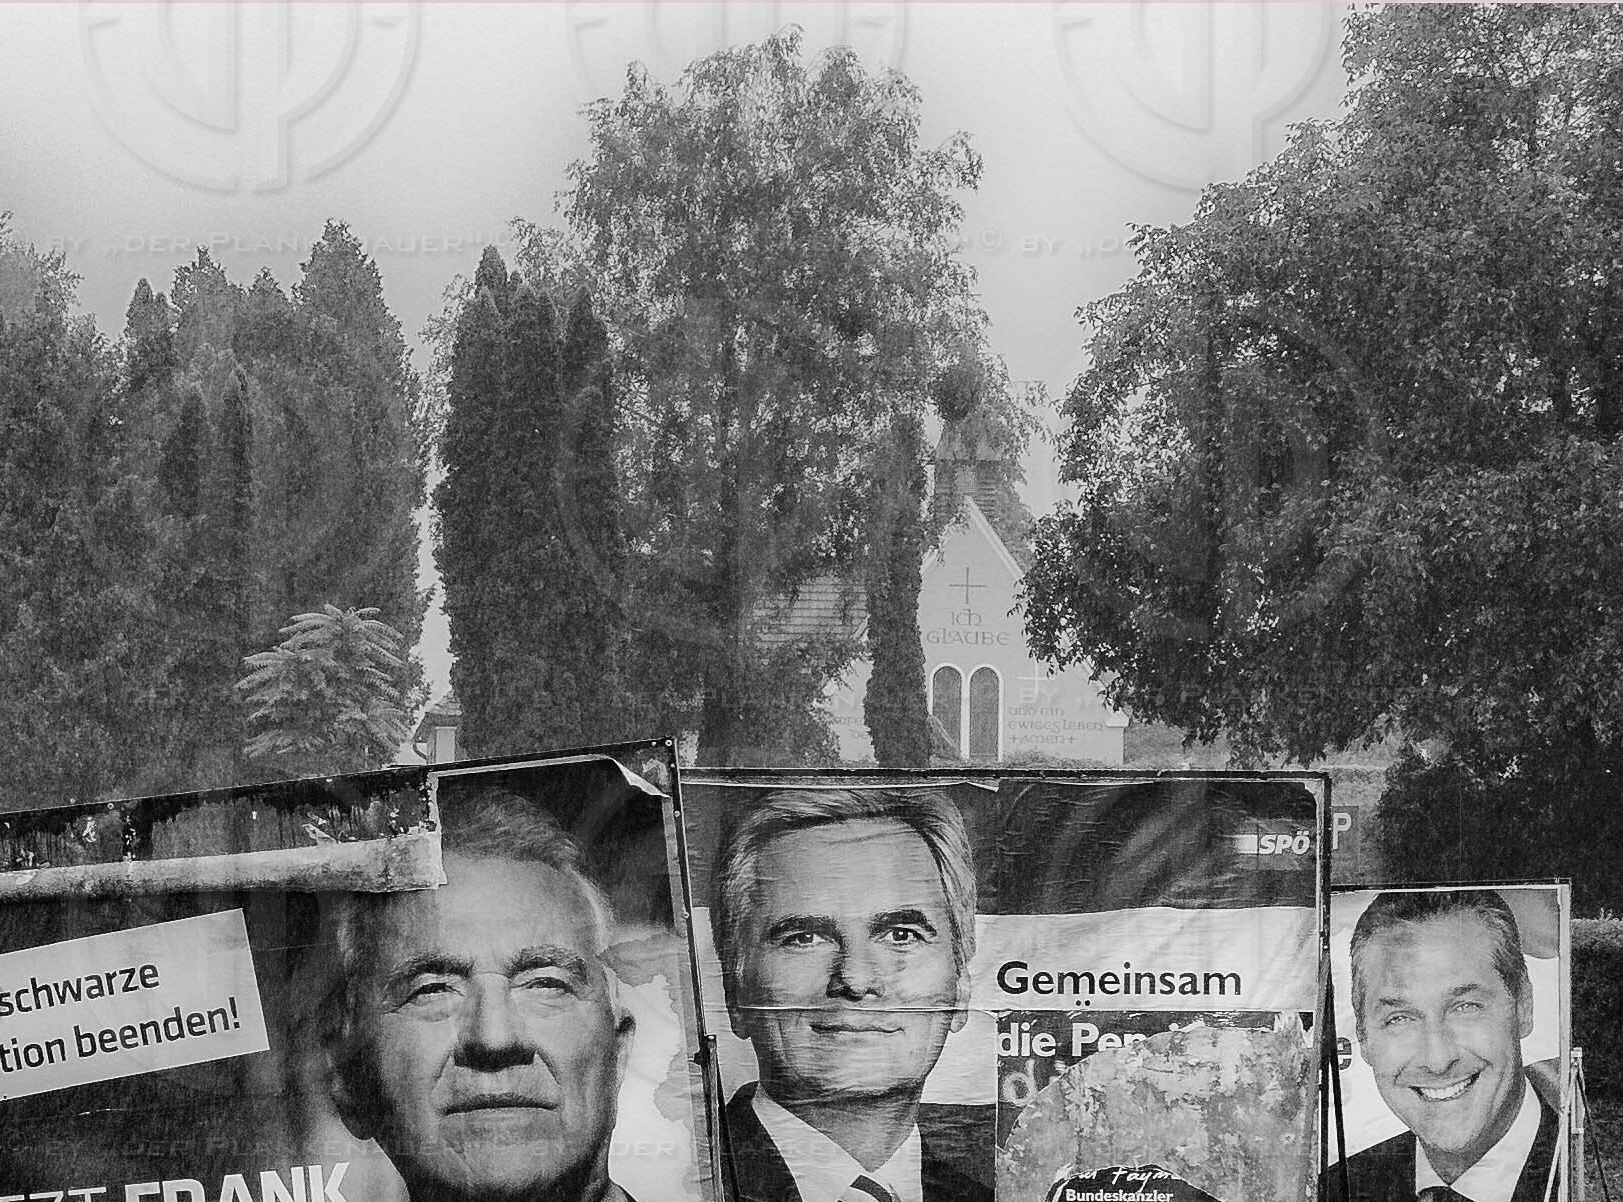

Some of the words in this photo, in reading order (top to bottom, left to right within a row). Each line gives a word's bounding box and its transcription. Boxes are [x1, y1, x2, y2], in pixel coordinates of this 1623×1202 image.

[1258, 830, 1311, 855] SPÖ
[1332, 812, 1352, 849] P
[996, 960, 1242, 996] Gemeinsam
[75, 995, 242, 1058] beenden!
[998, 1022, 1057, 1057] die
[1065, 1188, 1174, 1202] Bundeskanzler
